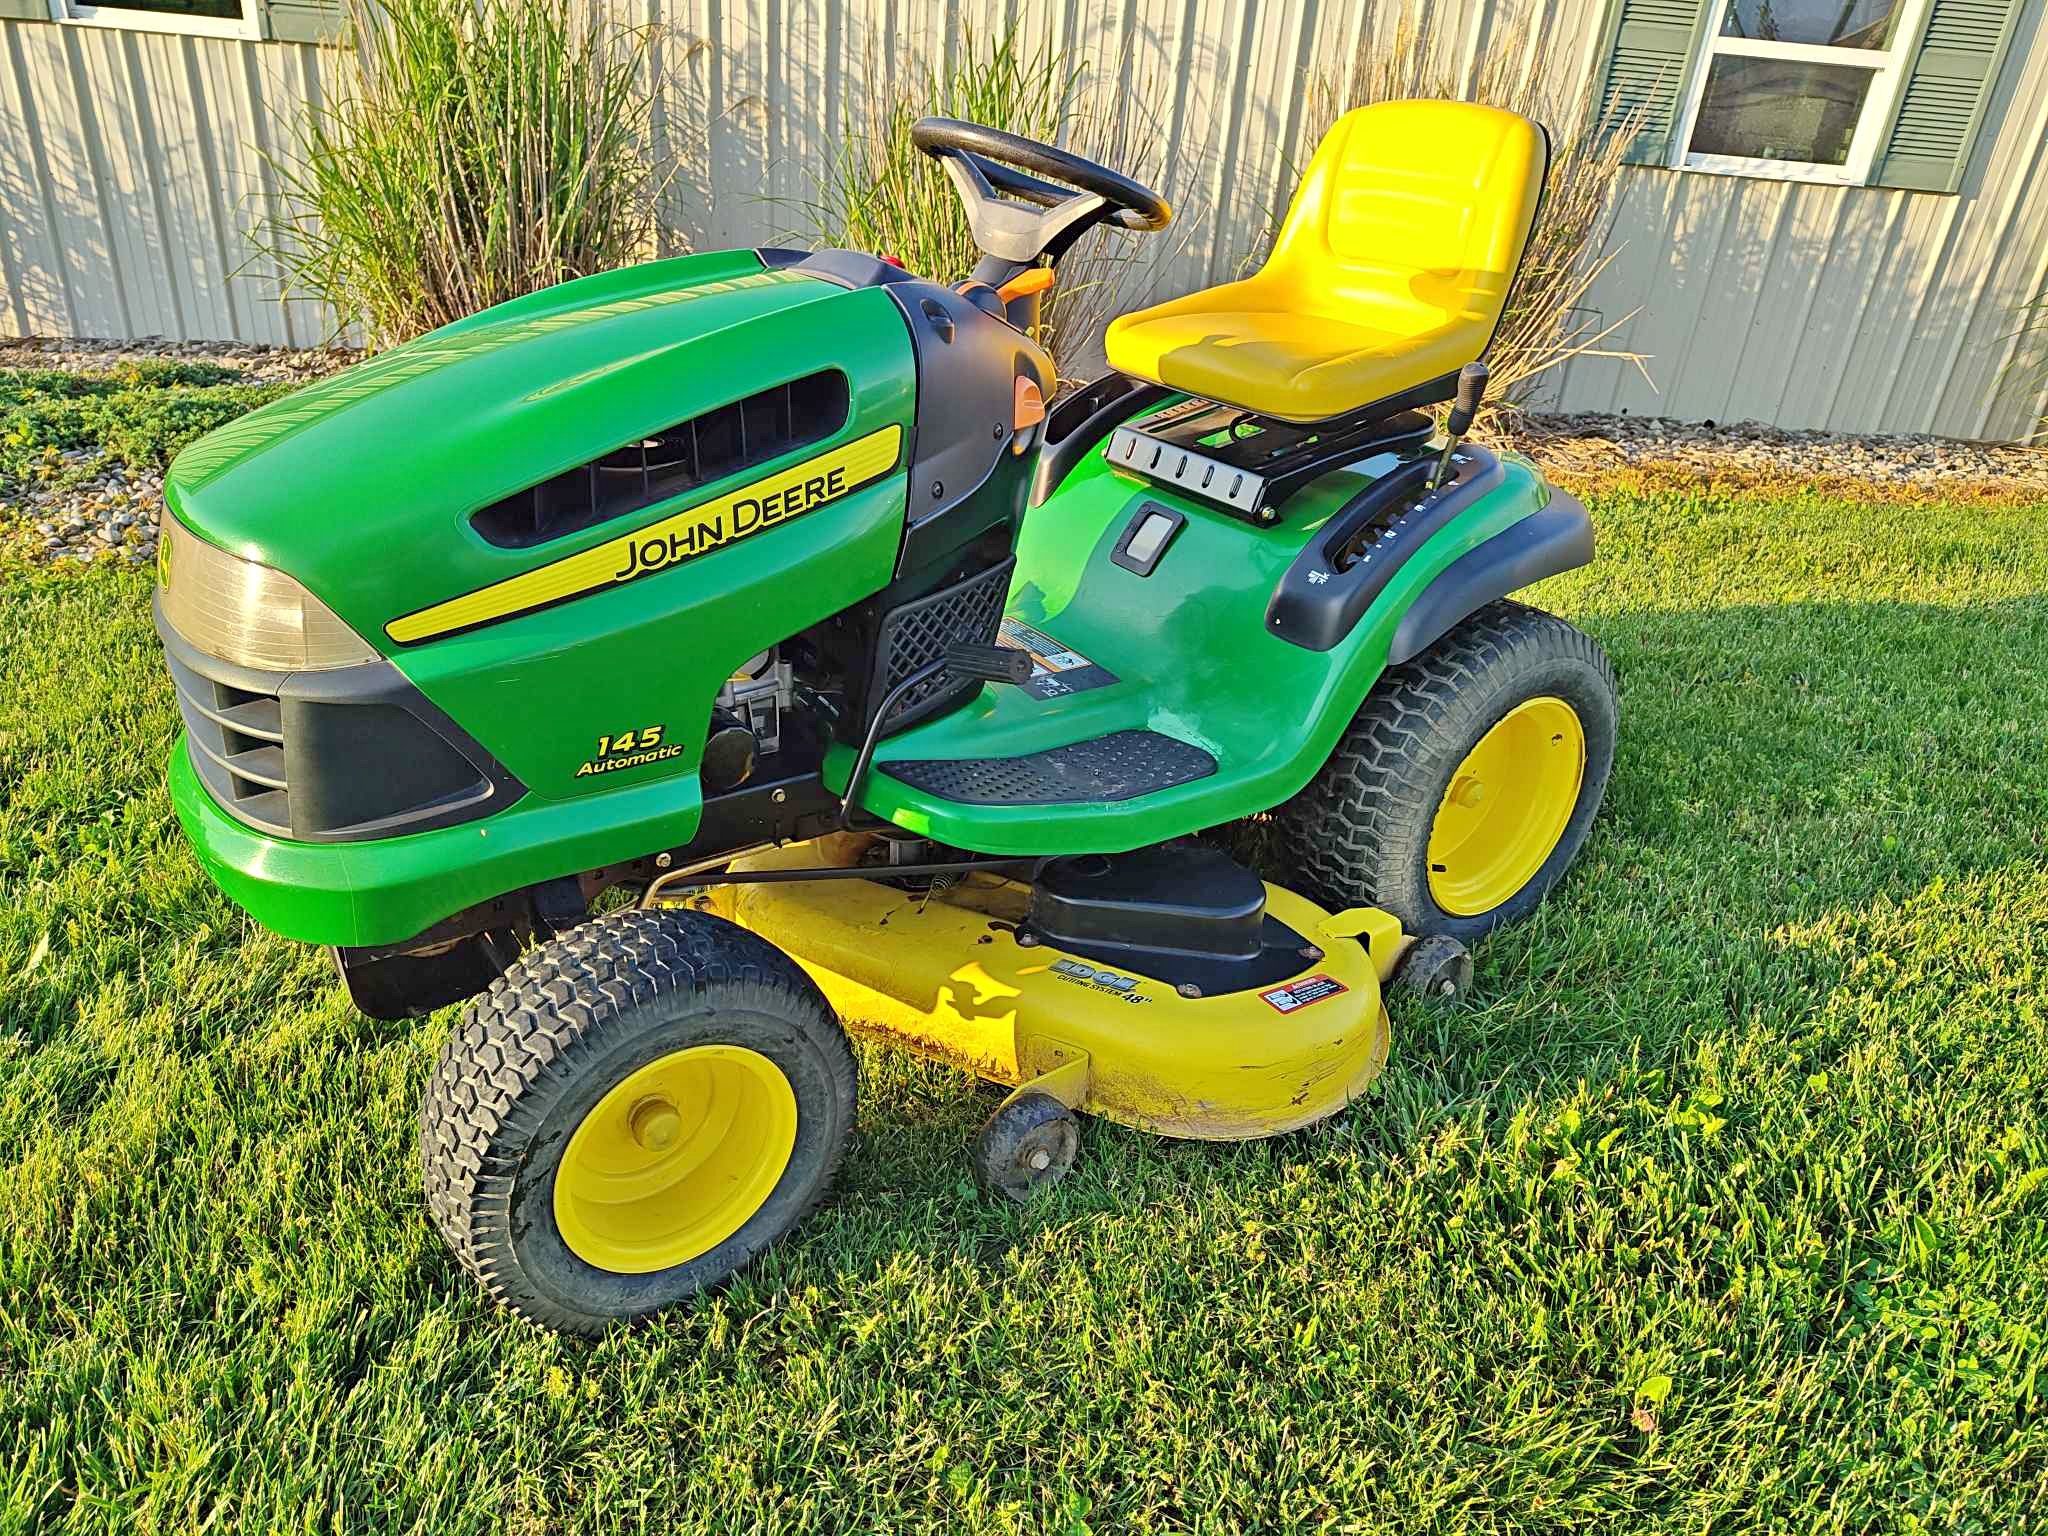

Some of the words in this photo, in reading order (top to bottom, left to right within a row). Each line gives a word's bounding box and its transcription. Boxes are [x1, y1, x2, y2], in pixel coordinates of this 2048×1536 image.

[615, 515, 723, 579] JOHN
[732, 466, 847, 535] DEERE
[597, 725, 664, 757] 145
[576, 744, 683, 777] Automatic
[1089, 984, 1122, 997] SYSTEM
